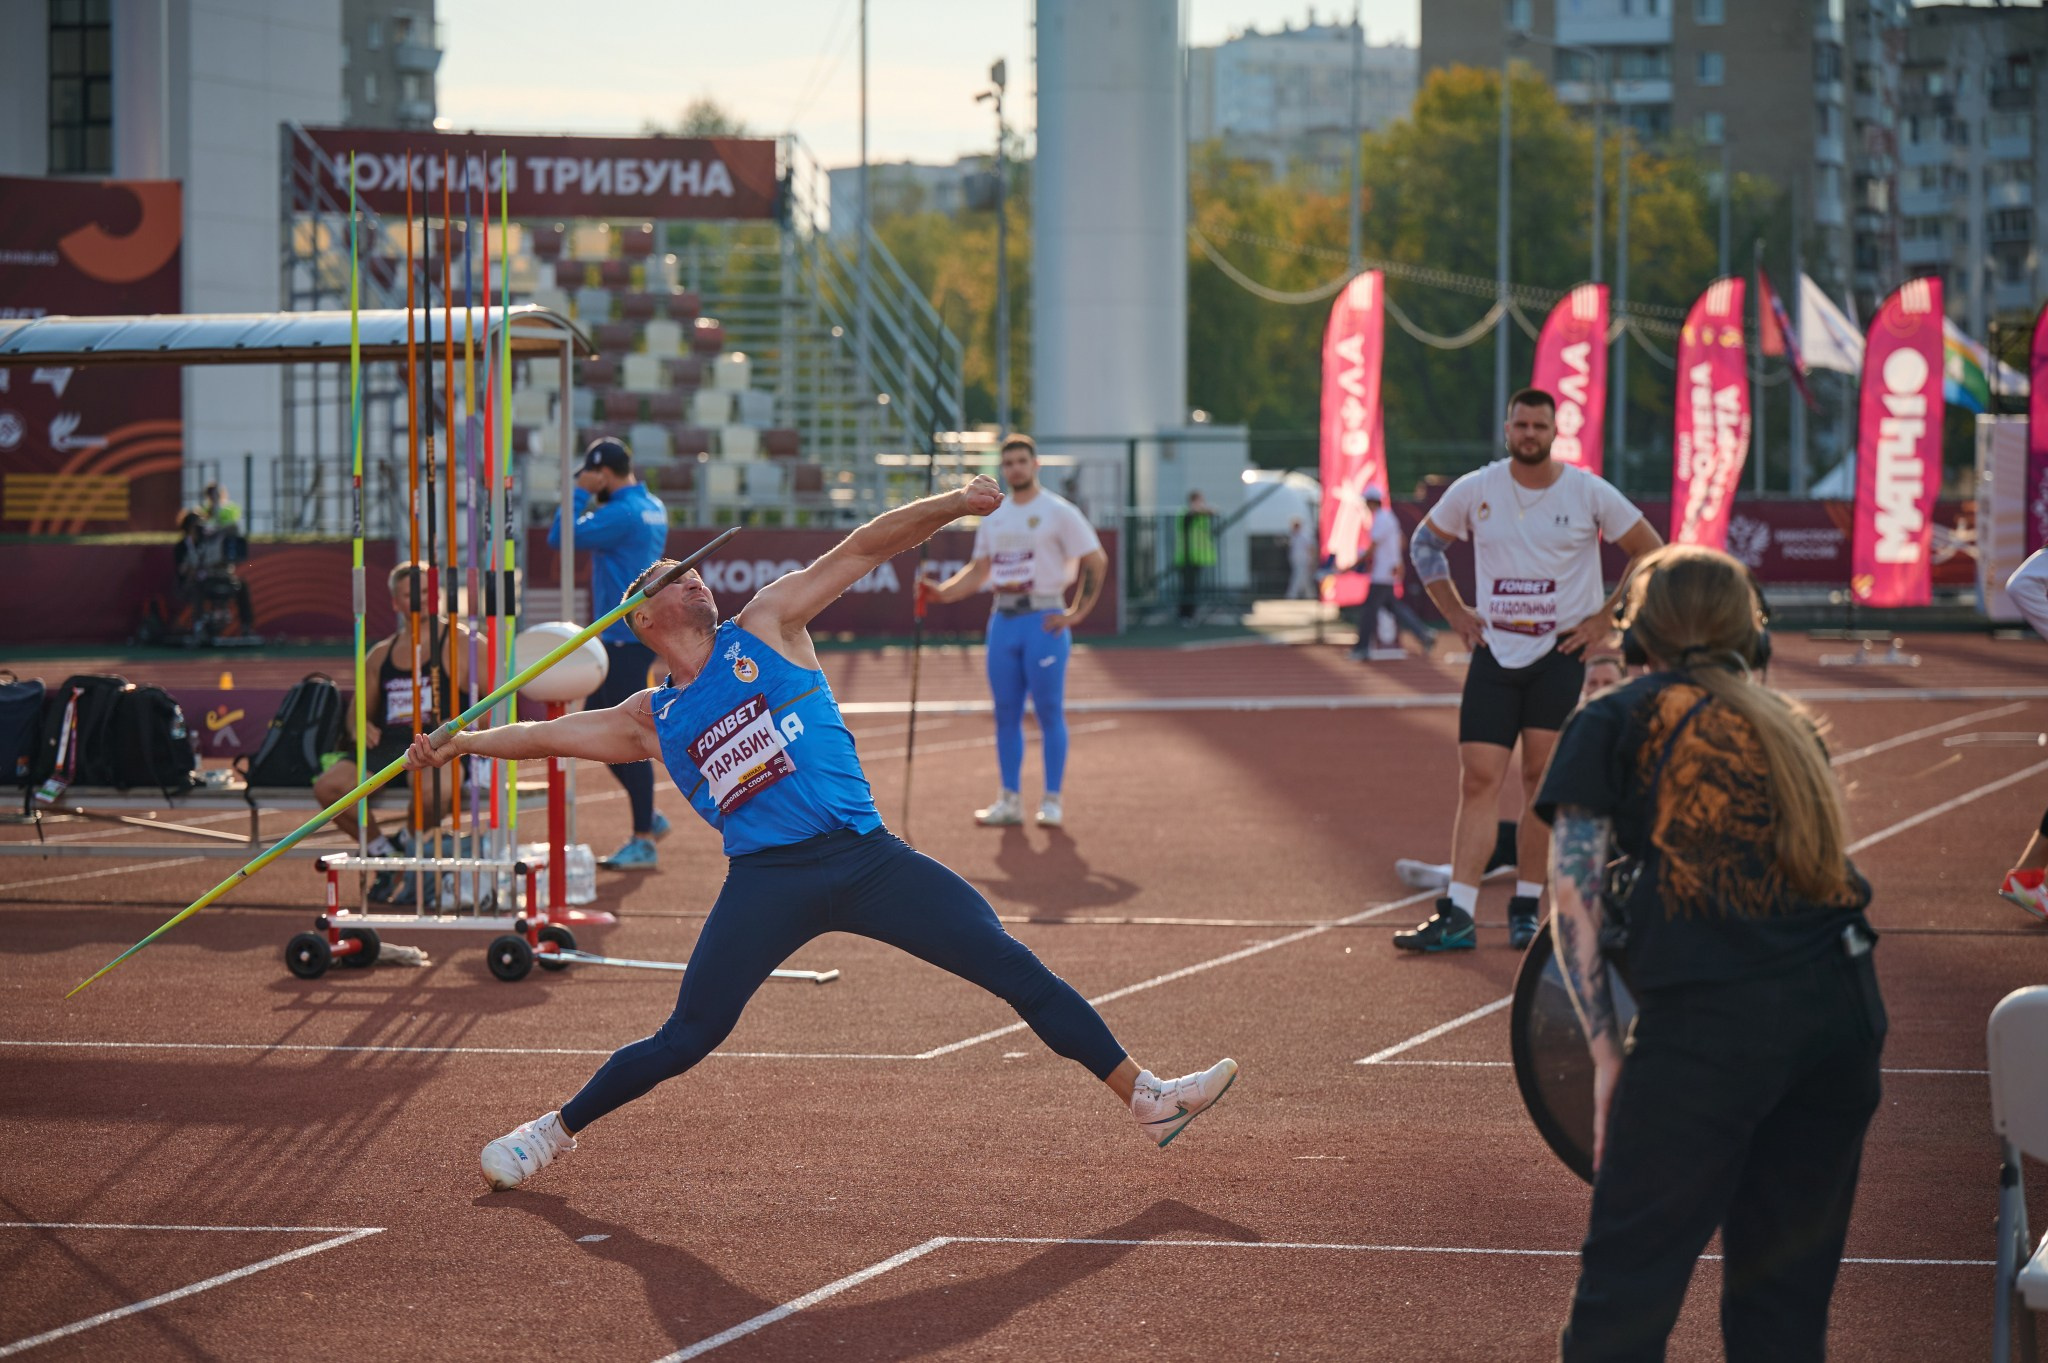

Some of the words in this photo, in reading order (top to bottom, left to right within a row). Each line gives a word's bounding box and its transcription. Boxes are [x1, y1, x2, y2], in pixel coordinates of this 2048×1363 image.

[333, 154, 518, 193] ЮЖНАЯ
[527, 158, 735, 197] ТРИБУНА
[1499, 579, 1550, 594] FONBET
[697, 700, 758, 757] FONBET
[707, 726, 774, 782] ТАРАБИН
[747, 770, 773, 788] СПОРТА
[513, 1146, 528, 1161] NIKE
